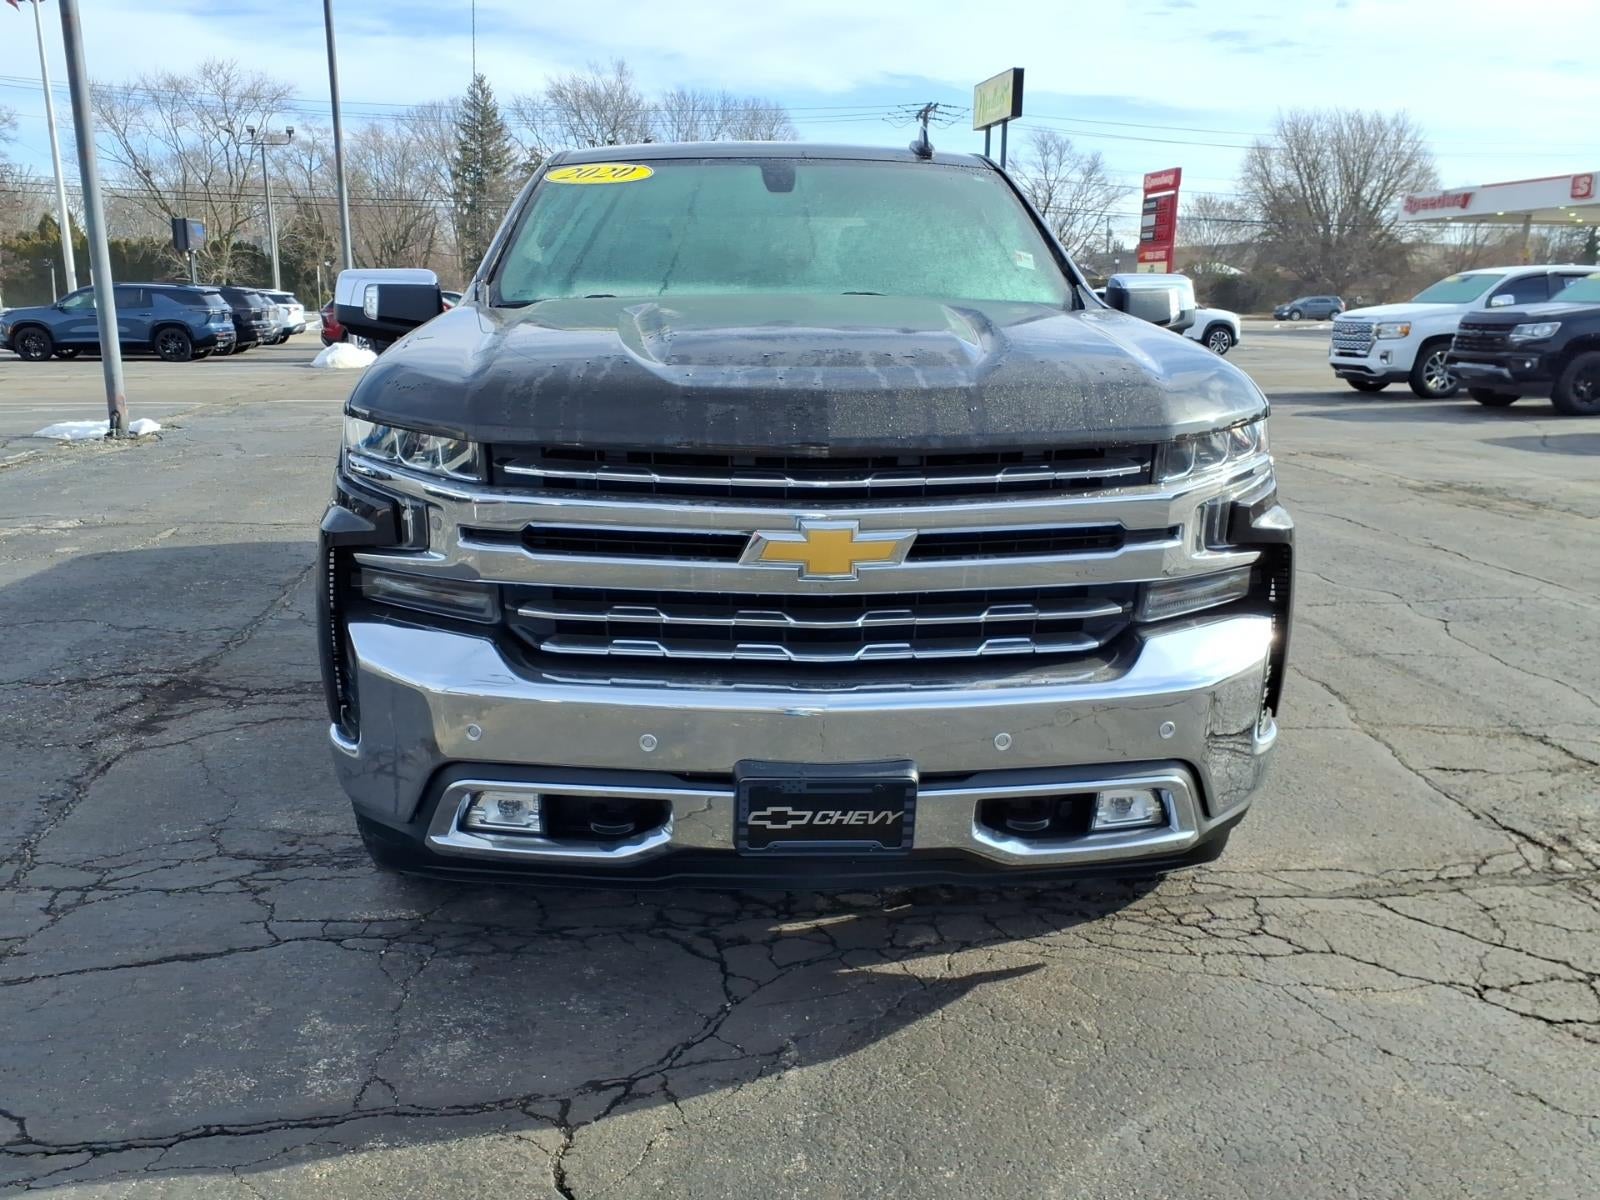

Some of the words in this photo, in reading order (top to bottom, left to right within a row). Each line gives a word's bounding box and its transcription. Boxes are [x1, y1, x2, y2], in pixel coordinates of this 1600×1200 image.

[556, 166, 638, 180] 2020
[1145, 174, 1175, 189] Speedway
[1403, 192, 1473, 215] Speedway
[812, 810, 905, 825] CHEVY
